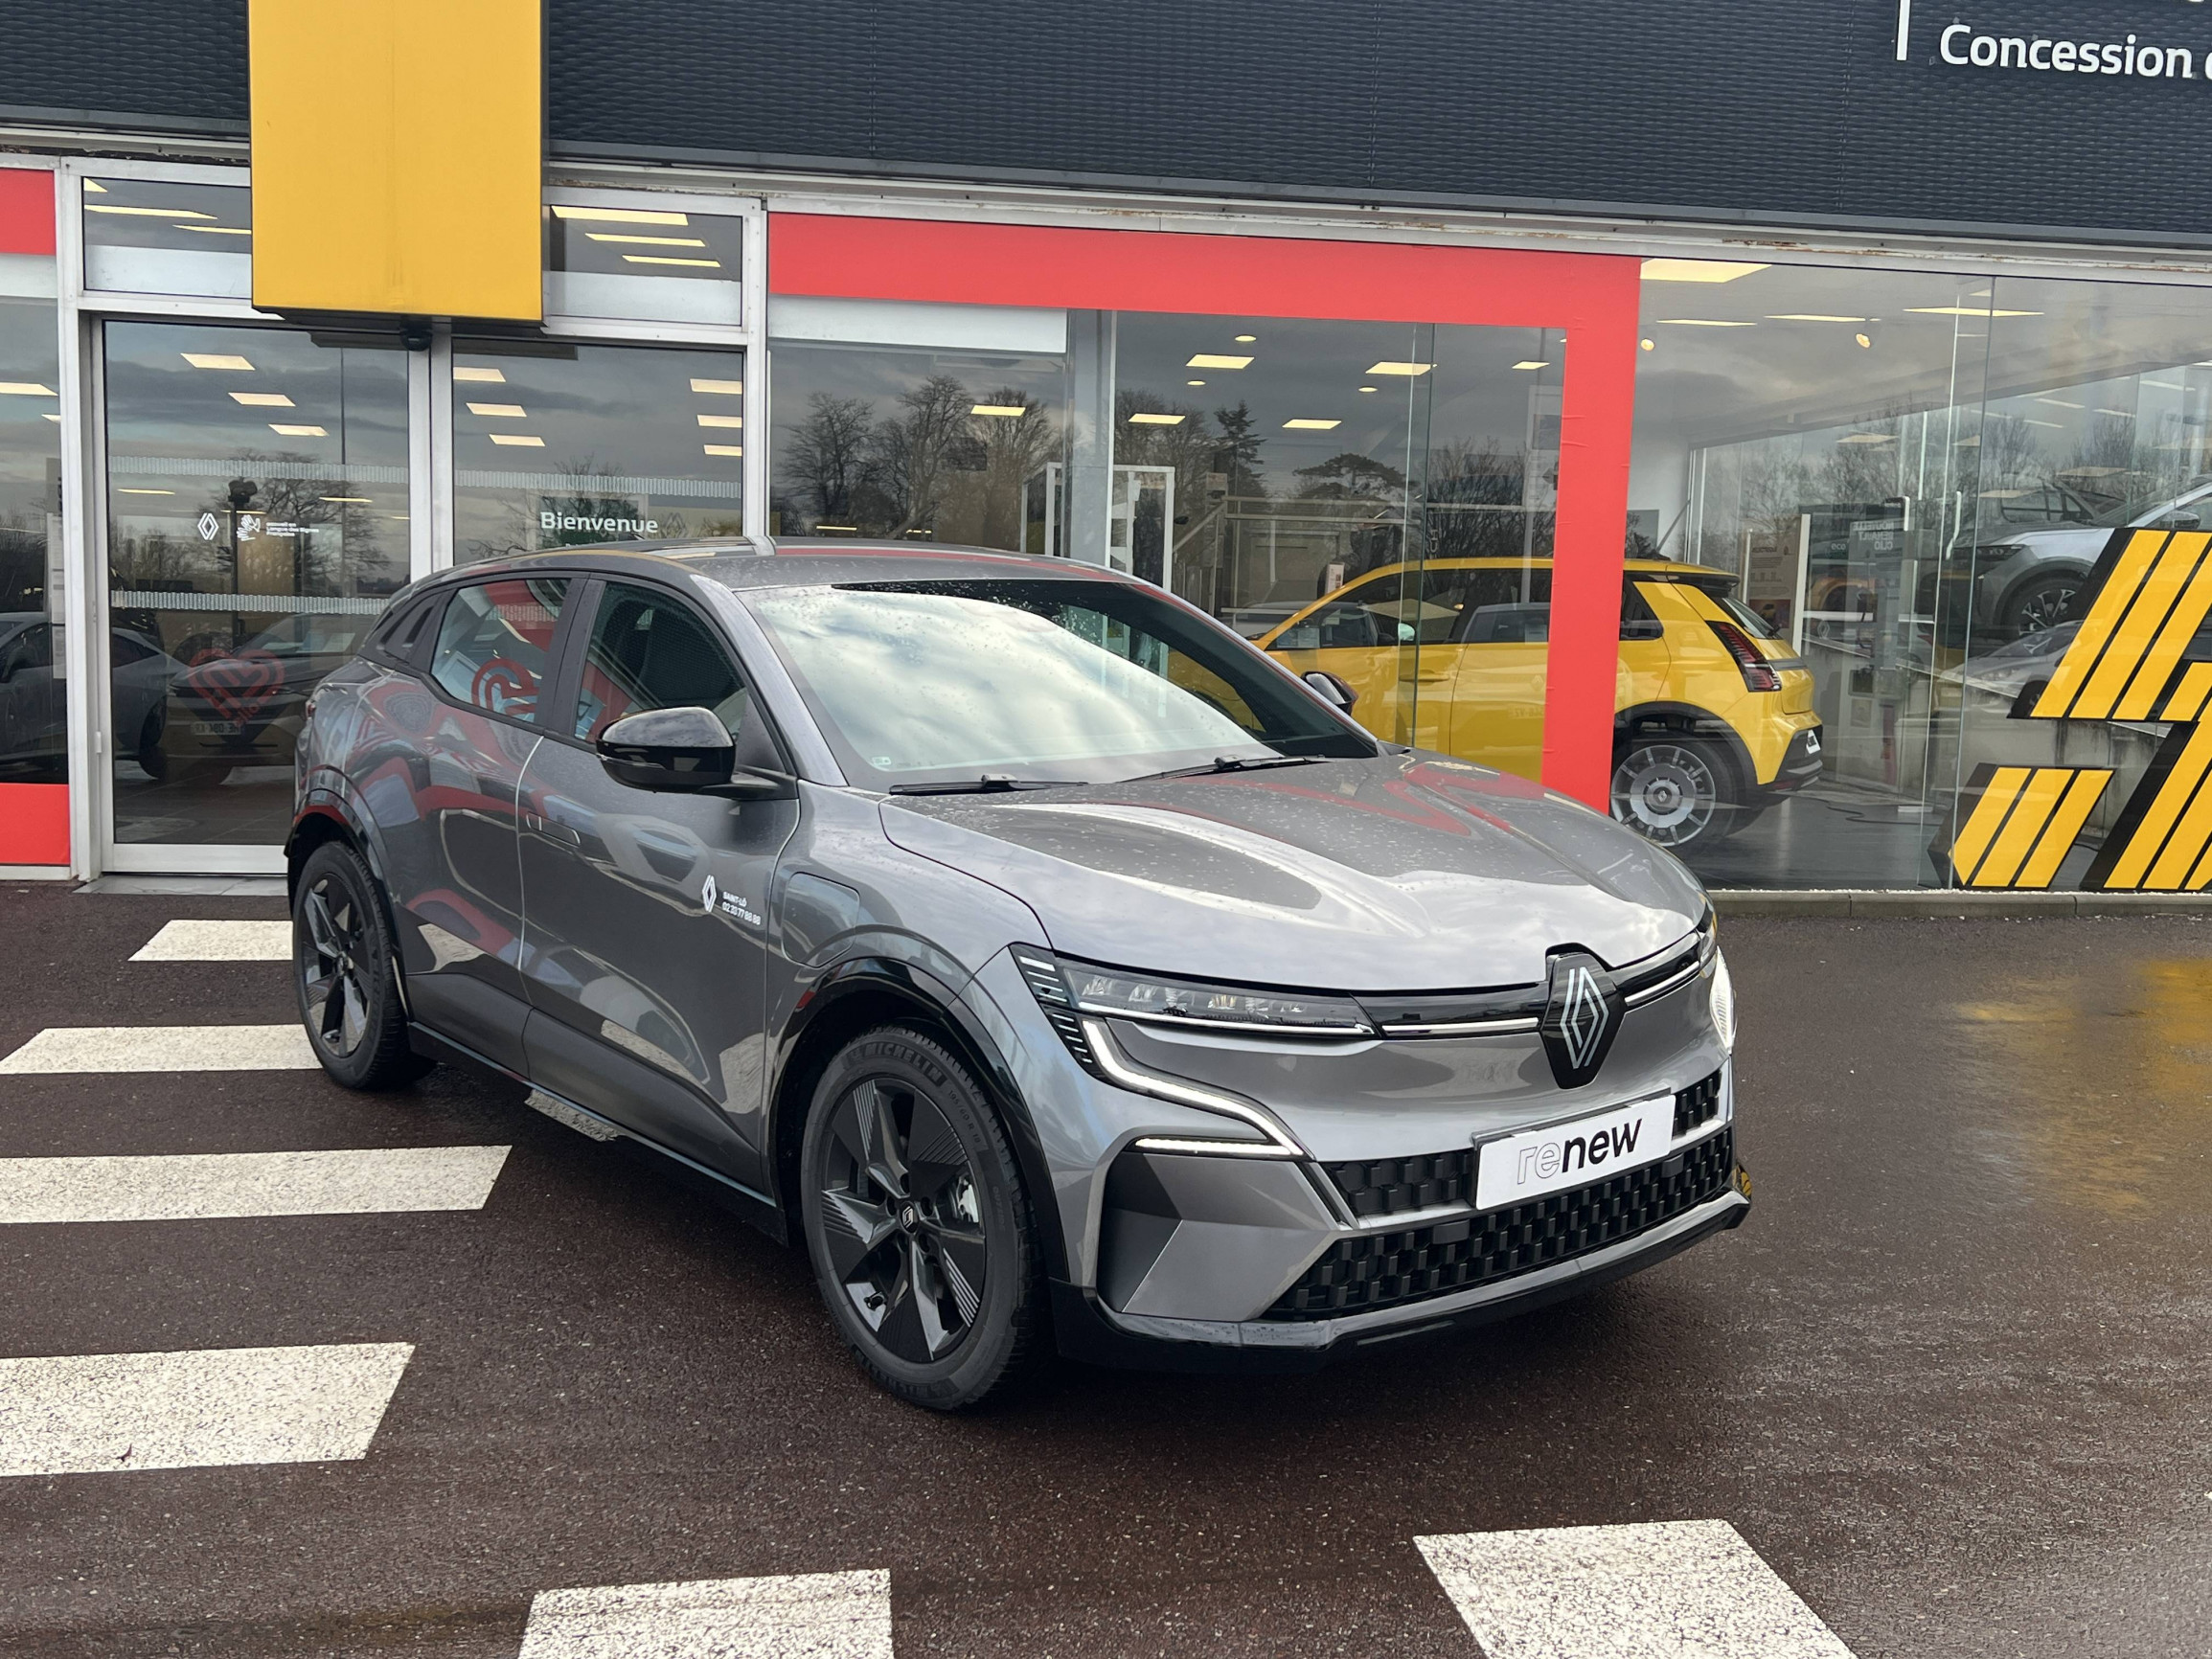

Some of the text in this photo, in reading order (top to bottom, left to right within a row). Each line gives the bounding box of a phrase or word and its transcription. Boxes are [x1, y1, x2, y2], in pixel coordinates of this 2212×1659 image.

[1940, 24, 2193, 79] Concession
[540, 511, 658, 534] Bienvenue
[863, 1042, 944, 1083] MICHELIN
[1516, 1118, 1642, 1184] renew
